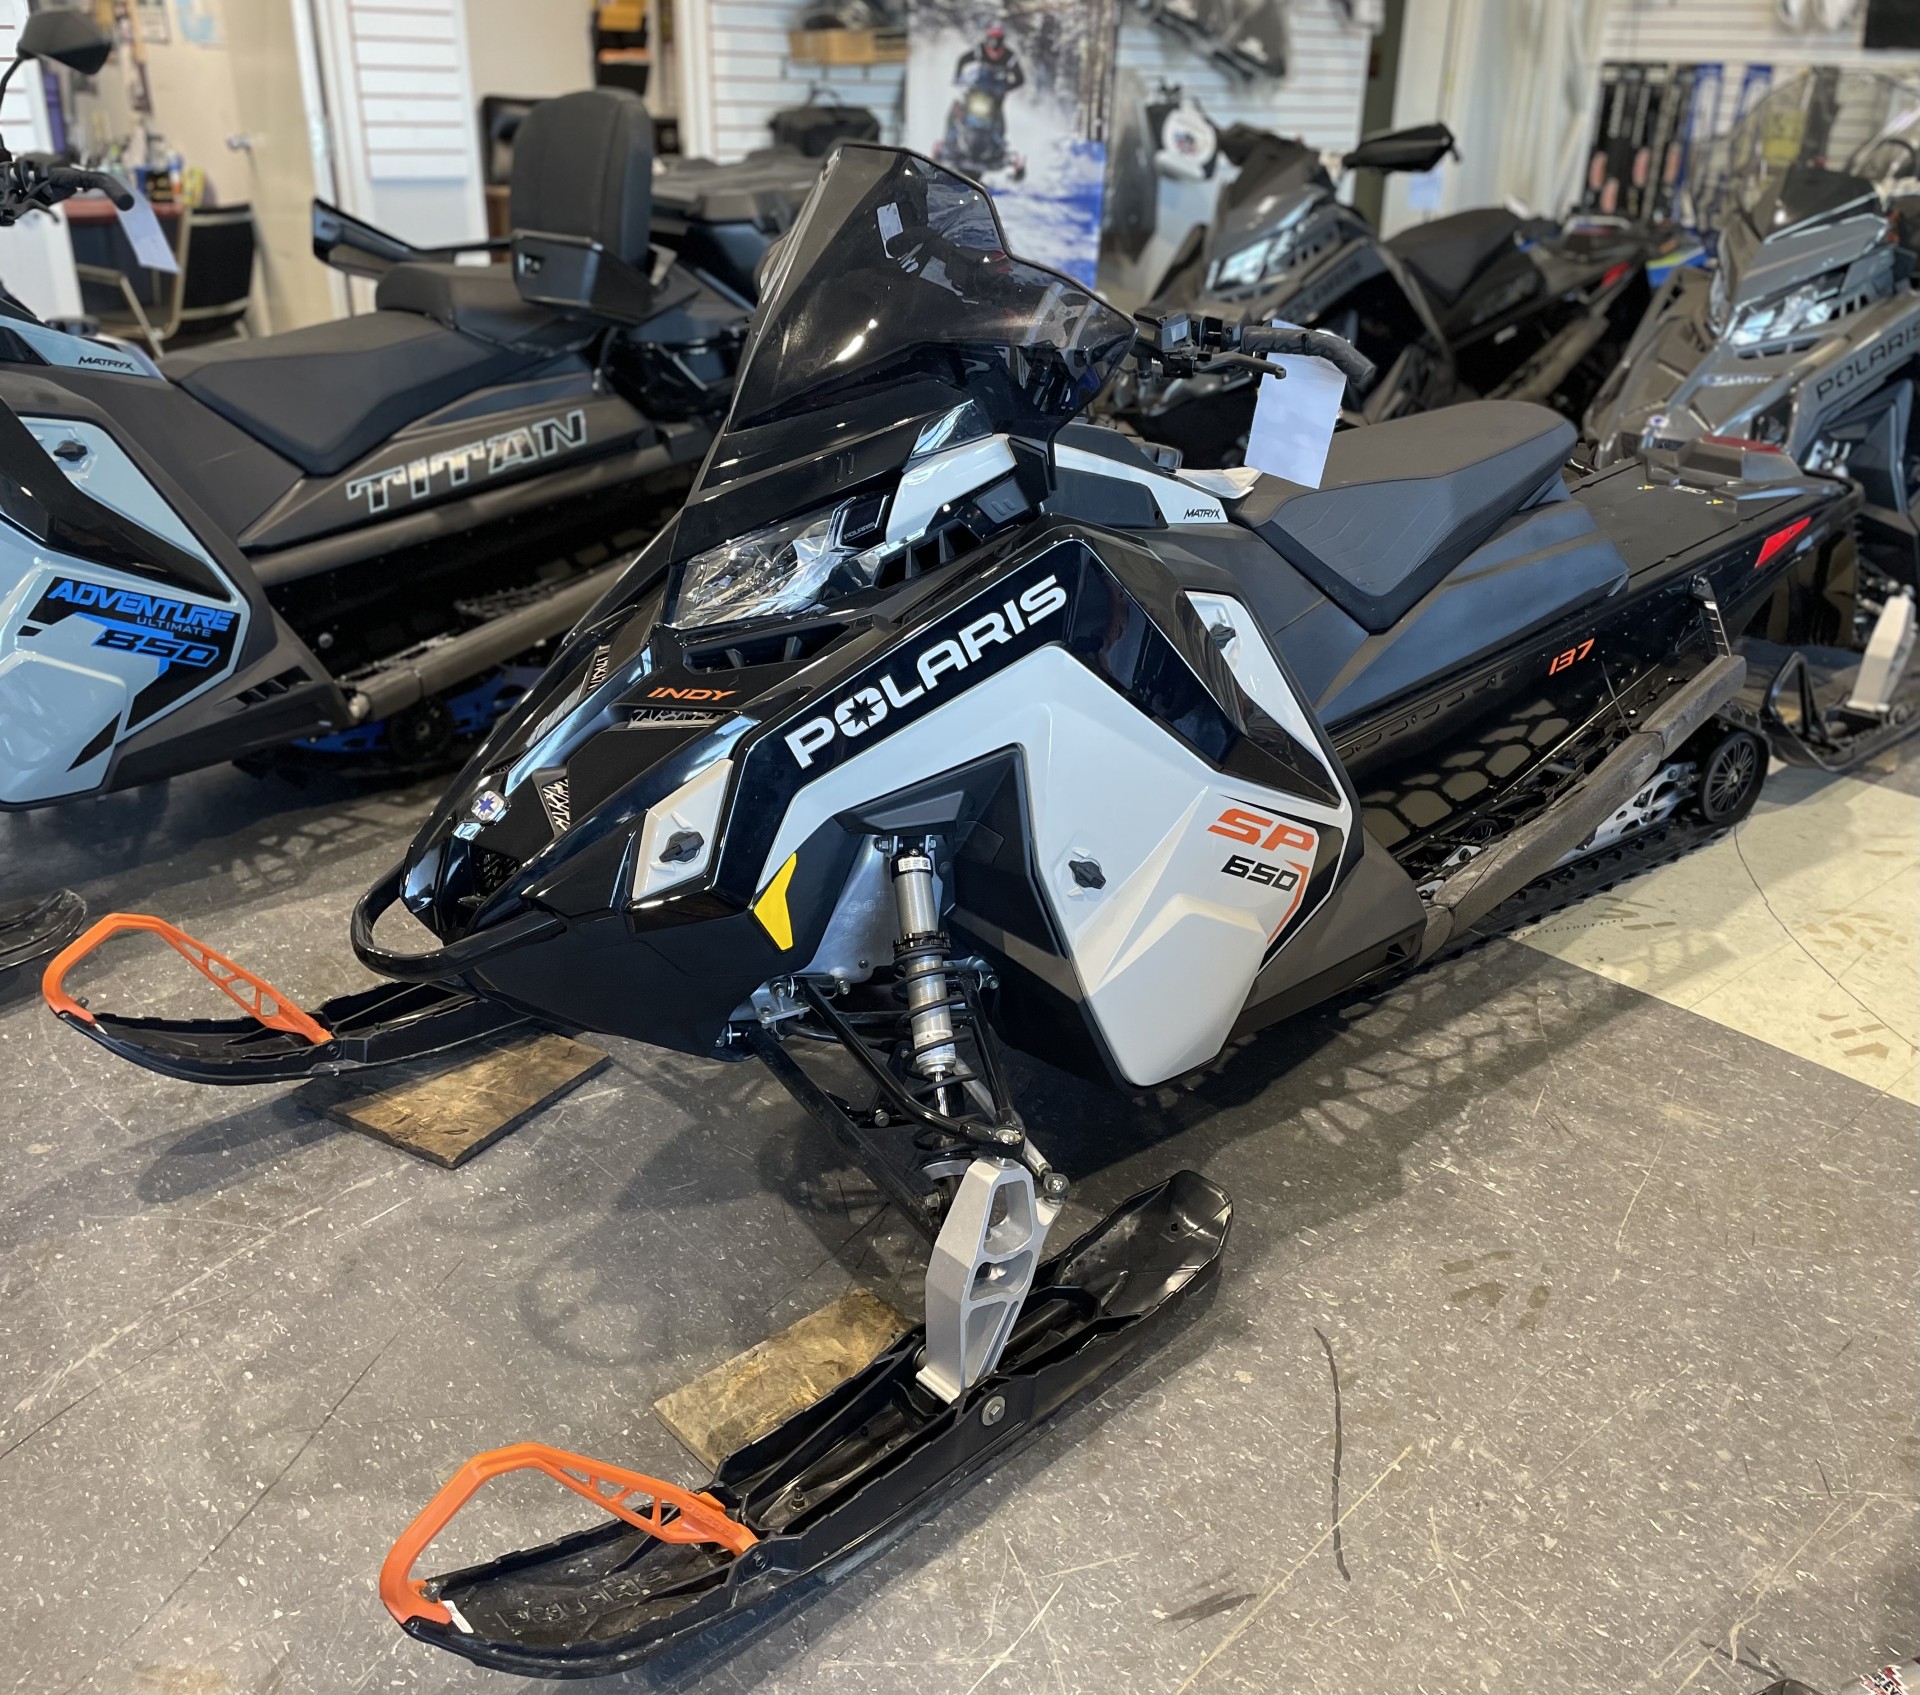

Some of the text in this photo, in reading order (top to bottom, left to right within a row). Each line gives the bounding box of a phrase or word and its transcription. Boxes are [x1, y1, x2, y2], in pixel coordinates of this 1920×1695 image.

[78, 356, 135, 371] MATRYX
[346, 409, 587, 513] TITAN
[1183, 508, 1220, 520] MATRYX
[47, 580, 236, 632] ADVENTURE
[136, 616, 212, 638] ULTIMATE
[92, 628, 220, 668] 850
[1548, 637, 1595, 676] 137
[784, 574, 1068, 770] POLARIS
[646, 687, 738, 701] INDY
[1206, 808, 1315, 852] SP
[1220, 854, 1300, 892] 650
